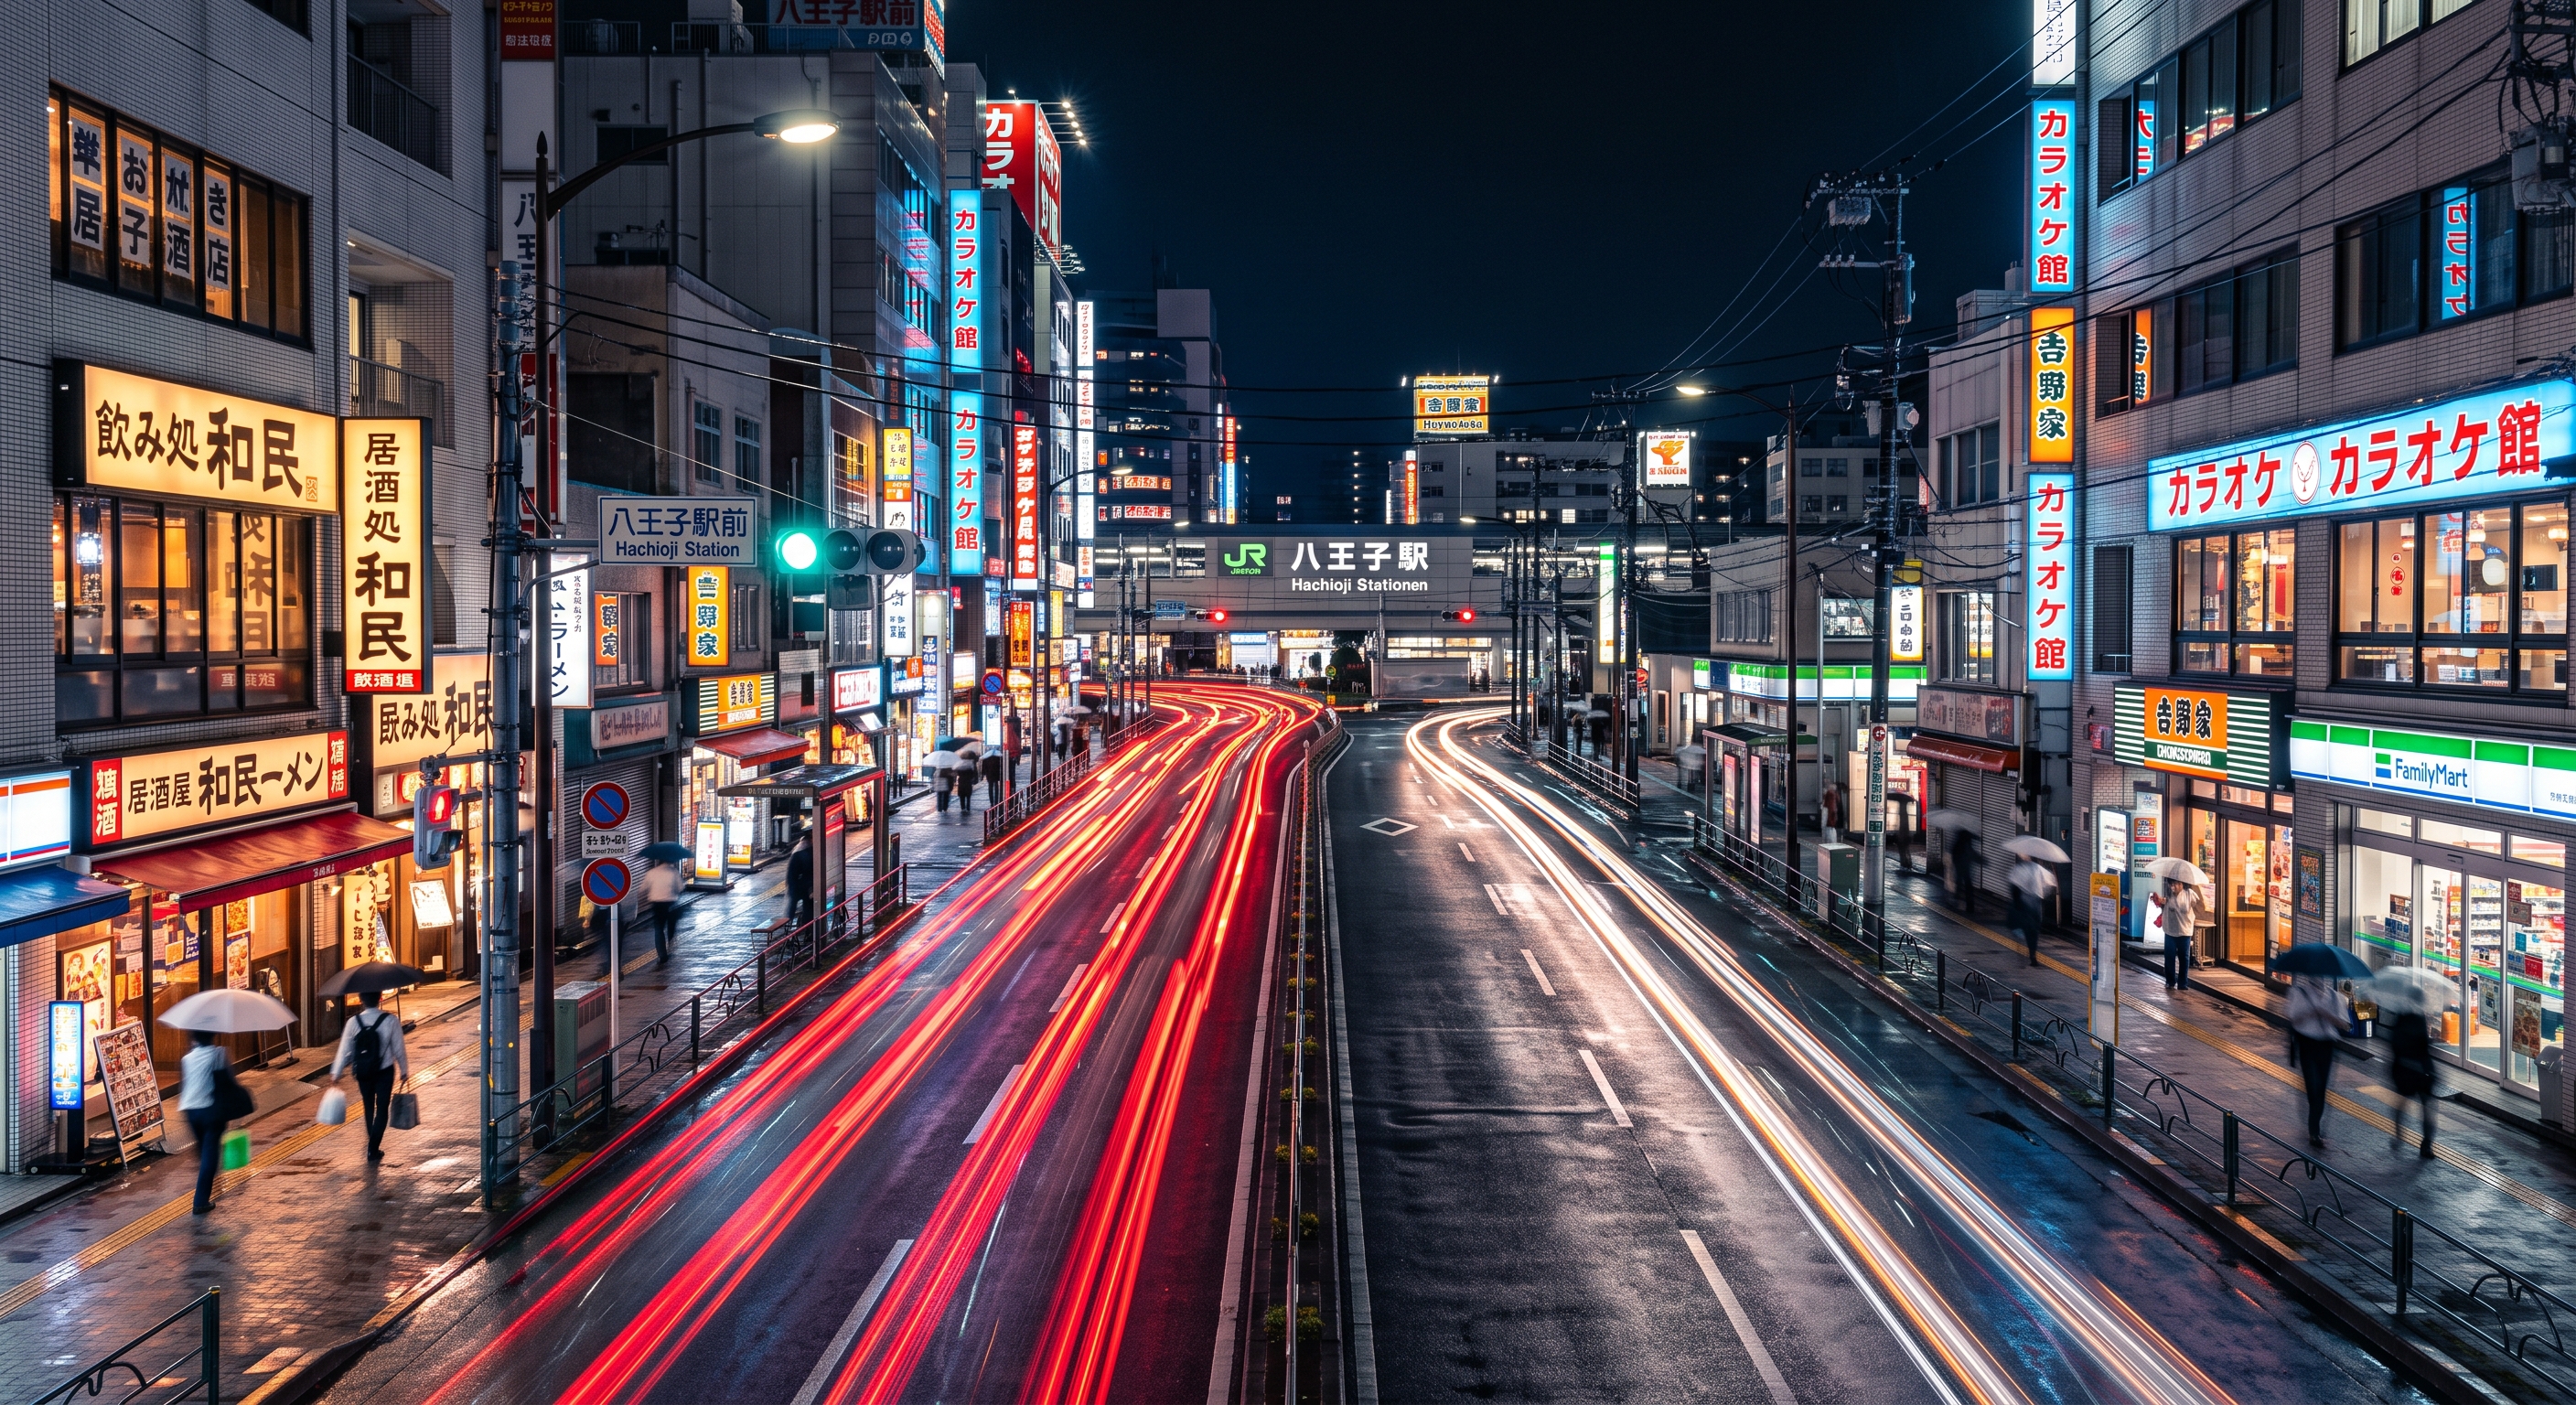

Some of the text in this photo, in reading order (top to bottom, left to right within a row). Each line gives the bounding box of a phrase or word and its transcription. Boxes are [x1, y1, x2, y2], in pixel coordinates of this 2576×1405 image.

[2037, 110, 2068, 284] カラオケ館
[955, 209, 977, 349] カラオケ館
[2038, 332, 2066, 439] 吉野家
[95, 400, 303, 499] 飲み処和民
[955, 409, 978, 550] カラオケ館
[2168, 399, 2543, 518] カラオケ カラオケ館
[355, 433, 413, 663] 居酒処和民
[608, 507, 748, 538] 八王子駅前
[616, 541, 740, 560] Hachioji Station
[1224, 543, 1267, 567] JR
[1291, 542, 1429, 571] 八王子駅
[1292, 578, 1428, 595] Hachioji Stationen
[2034, 483, 2066, 669] カラオケ館
[2395, 757, 2468, 789] FamilyMart
